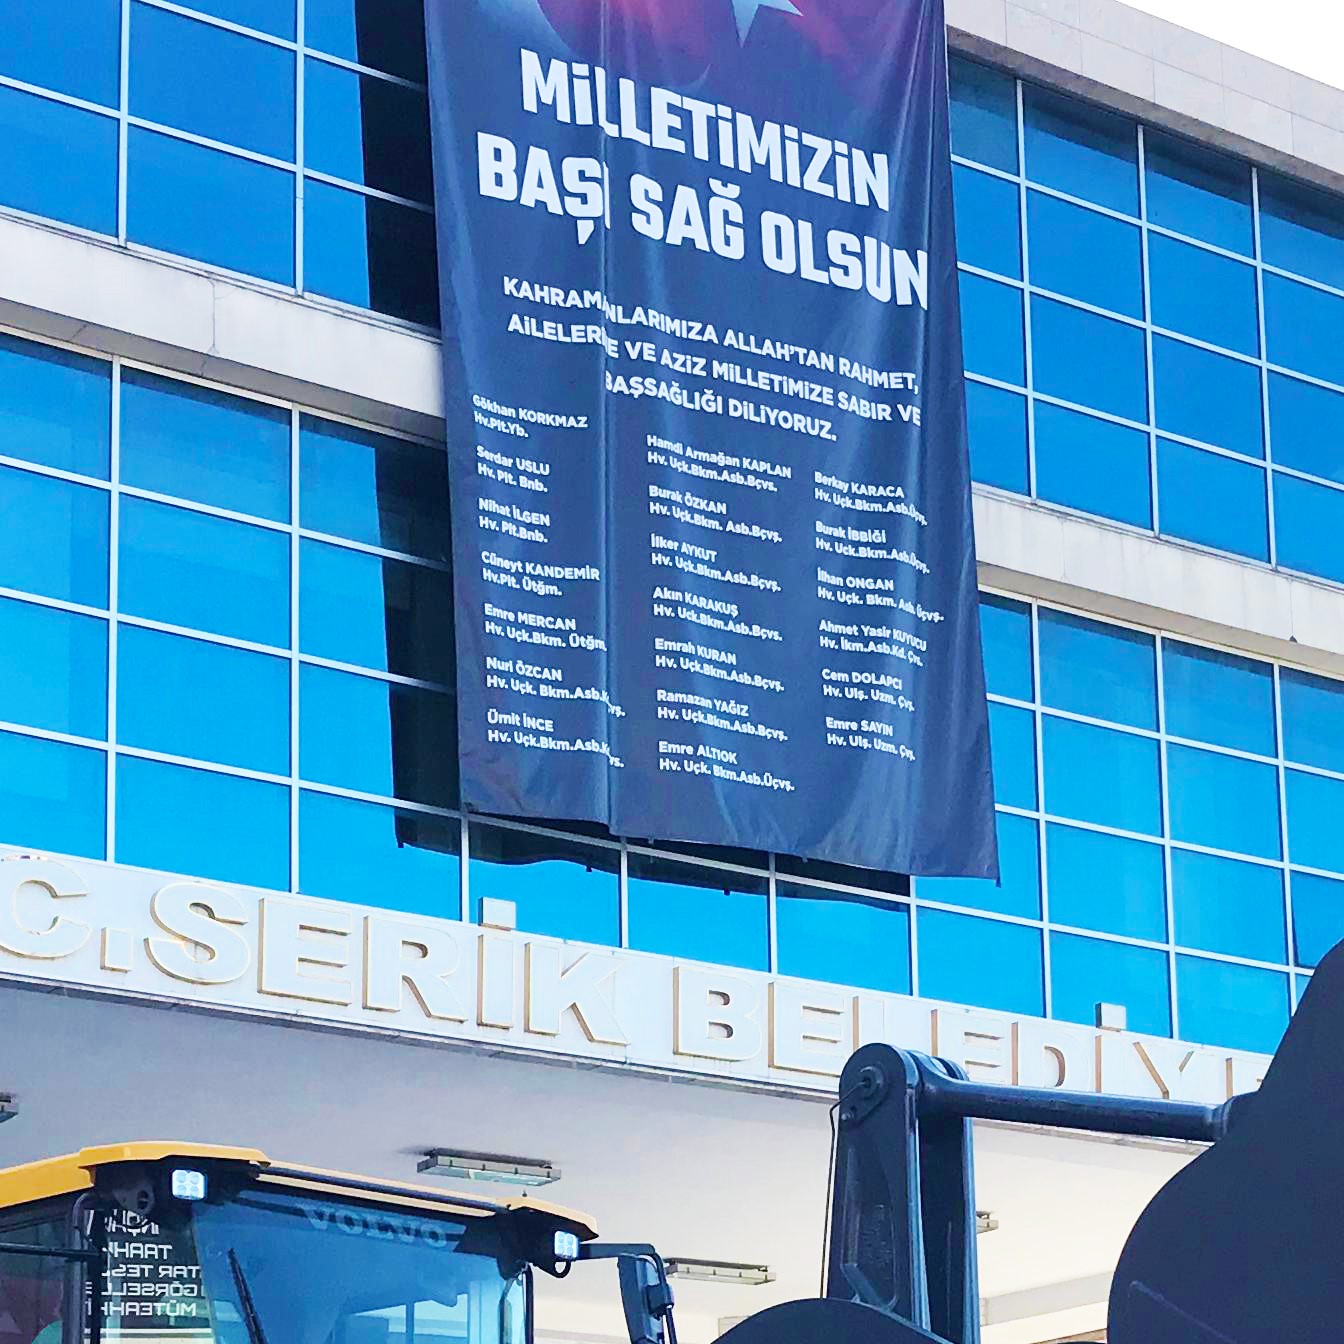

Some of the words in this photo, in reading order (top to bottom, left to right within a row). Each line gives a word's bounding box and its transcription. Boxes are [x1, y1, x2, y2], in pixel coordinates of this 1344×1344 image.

[629, 172, 745, 261] SAĞ
[760, 210, 928, 311] OLSUN
[624, 341, 656, 362] VE
[837, 390, 892, 421] SABIR
[896, 403, 921, 427] VE
[838, 357, 919, 395] RAHMET,
[472, 394, 517, 419] Gökhan
[518, 408, 589, 428] KORKMAZ
[476, 445, 514, 468] Serdar
[515, 457, 550, 476] USLU
[646, 434, 684, 455] Hamdi
[685, 446, 740, 467] Armağan
[742, 457, 792, 479] KAPLAN
[647, 451, 668, 467] Hv.
[477, 462, 496, 479] Hv.
[519, 475, 548, 493] Bnb.
[814, 471, 849, 494] Berkay
[851, 482, 905, 499] KARACA
[648, 485, 683, 504] Burak
[684, 491, 727, 515] ÖZKAN
[814, 487, 832, 503] Hv.
[478, 497, 511, 517] Nihat
[512, 504, 551, 527] İLGEN
[649, 502, 671, 516] Hv.
[479, 515, 500, 531] Hv.
[815, 520, 846, 539] Burak
[681, 542, 718, 563] AYKUT
[816, 537, 833, 552] Hv.
[481, 550, 523, 573] Cüneyt
[525, 564, 600, 581] KANDEMİR
[651, 553, 673, 567] Hv.
[846, 576, 894, 591] ONGAN
[652, 586, 683, 602] Akın
[685, 591, 739, 618] KARAKUŞ
[817, 586, 835, 601] Hv.
[865, 594, 897, 609] Bkm.
[484, 602, 515, 622] Emre
[517, 611, 577, 631] MERCAN
[653, 603, 675, 618] Hv.
[485, 621, 505, 637] Hv.
[819, 619, 858, 636] Ahmet
[860, 624, 892, 639] Yasir
[655, 637, 696, 655] Emrah
[697, 645, 737, 666] KURAN
[819, 636, 839, 650] Hv.
[486, 656, 513, 673] Nuri
[515, 660, 563, 682] ÖZCAN
[655, 655, 678, 669] Hv.
[486, 675, 508, 689] Hv.
[821, 668, 850, 683] Cem
[823, 684, 843, 697] Hv.
[656, 689, 713, 710] Ramazan
[714, 698, 750, 717] YAĞIZ
[657, 707, 680, 720] Hv.
[487, 709, 521, 726] Ümit
[522, 713, 555, 732] İNCE
[825, 716, 858, 731] Emre
[860, 720, 894, 737] SAYIN
[487, 729, 512, 743] Hv.
[826, 733, 847, 746] Hv.
[658, 741, 694, 755] Emre
[696, 744, 738, 765] ALTIOK
[659, 758, 682, 771] Hv.
[304, 1203, 447, 1248] VOLVO
